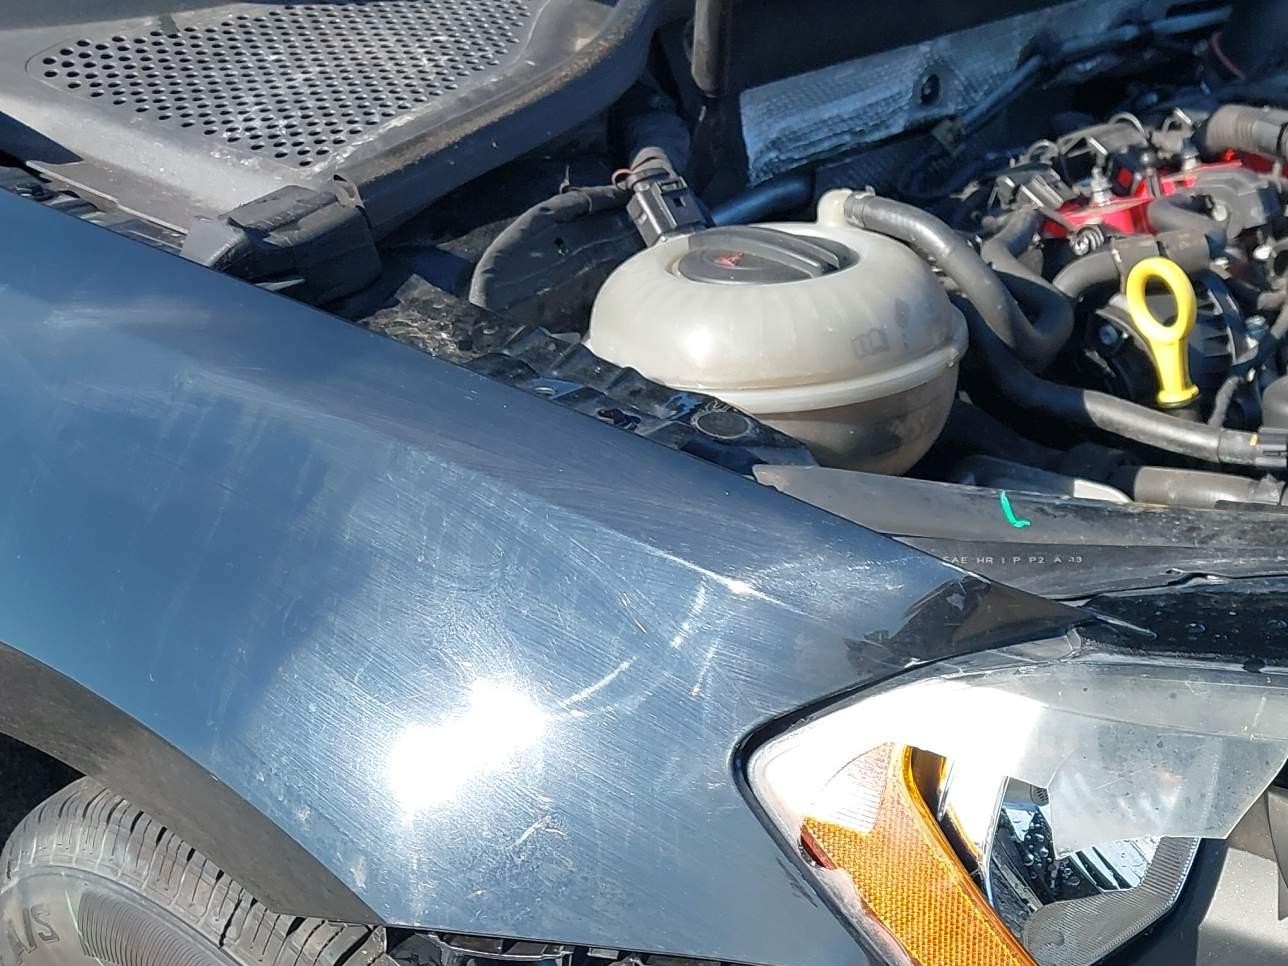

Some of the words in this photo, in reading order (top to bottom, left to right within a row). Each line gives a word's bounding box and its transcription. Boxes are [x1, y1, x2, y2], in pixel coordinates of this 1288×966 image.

[976, 556, 993, 565] HR
[1012, 556, 1021, 565] P
[1029, 556, 1047, 564] P2
[1053, 556, 1063, 564] A
